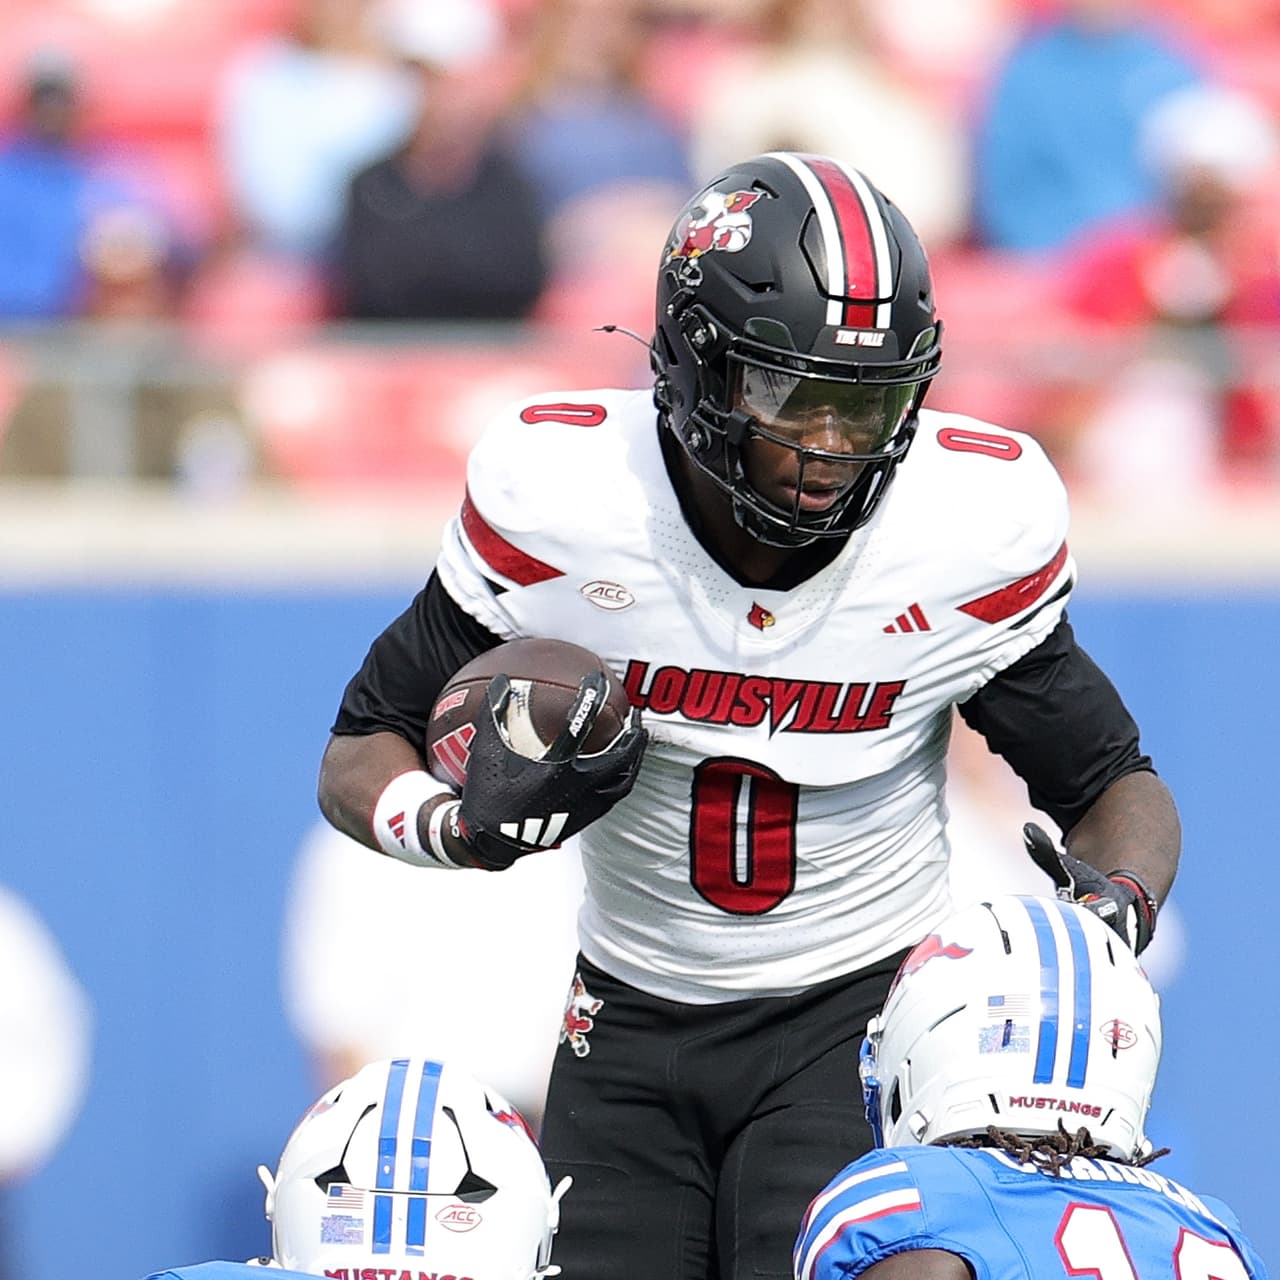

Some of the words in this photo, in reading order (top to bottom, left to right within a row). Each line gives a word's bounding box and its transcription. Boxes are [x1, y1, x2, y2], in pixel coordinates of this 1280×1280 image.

[590, 586, 627, 601] ACC
[568, 687, 597, 738] ADIZERO
[623, 659, 908, 740] LOUISVILLE
[689, 755, 797, 915] 0
[1009, 1096, 1103, 1118] MUSTANGS
[442, 1210, 476, 1223] ACC
